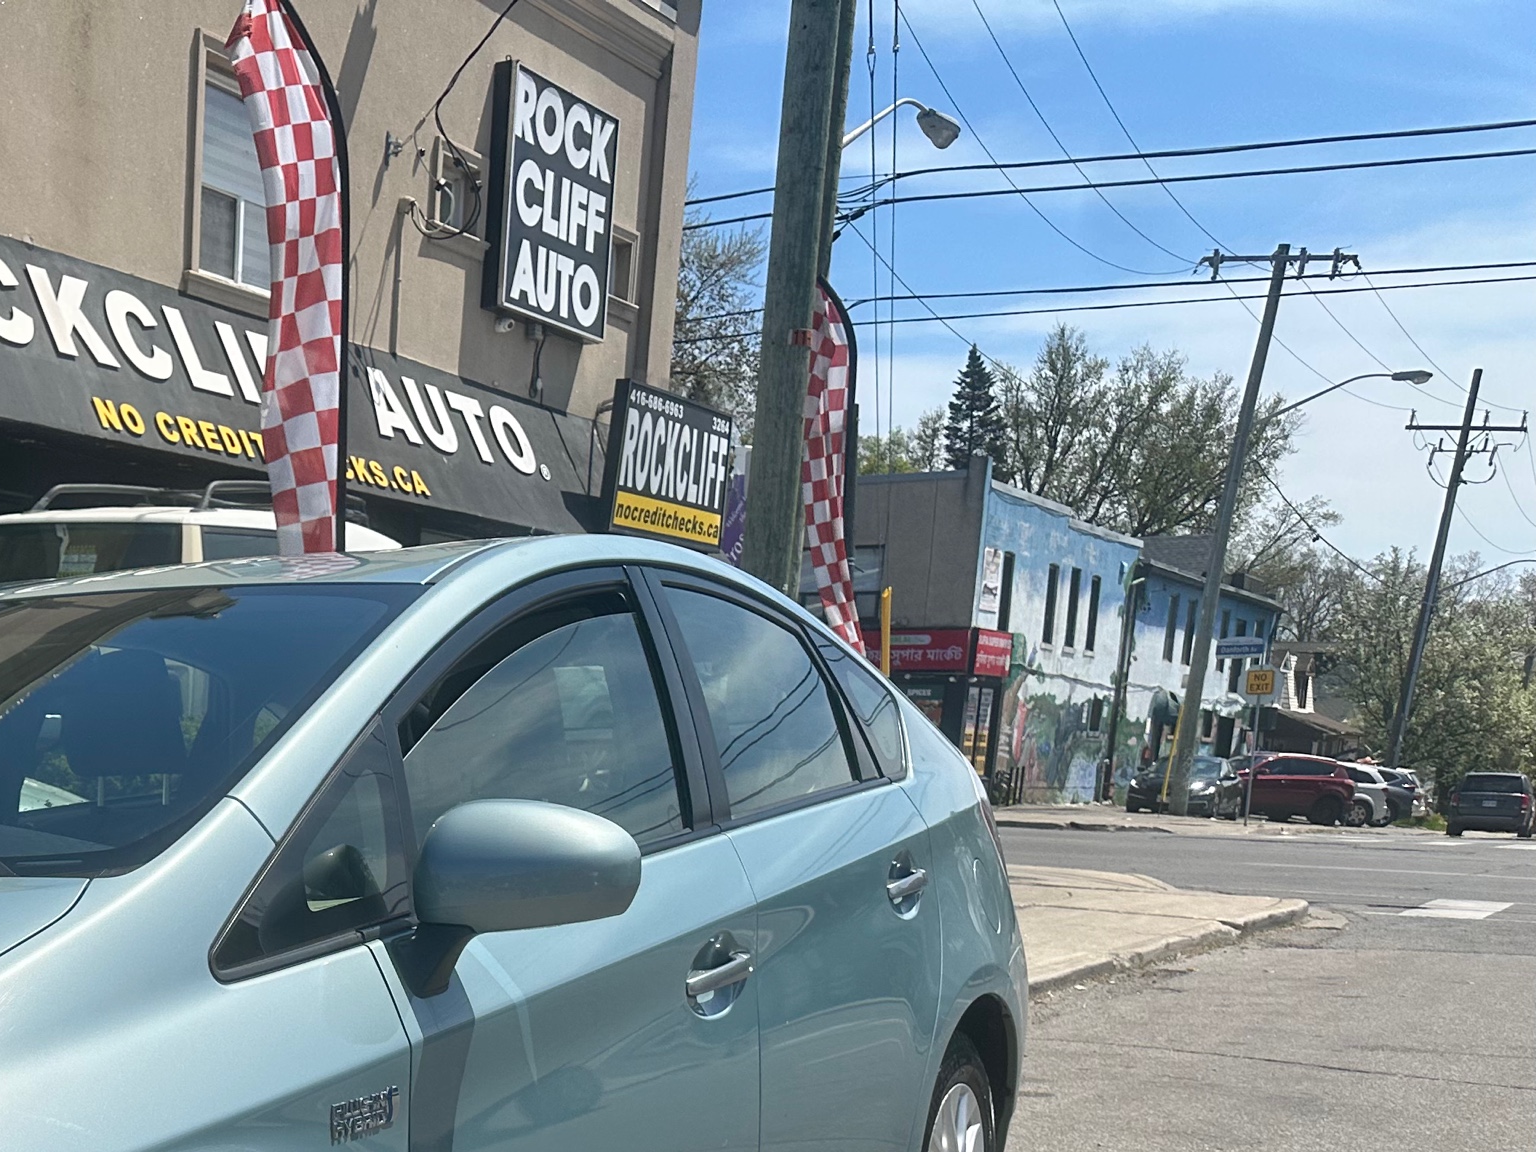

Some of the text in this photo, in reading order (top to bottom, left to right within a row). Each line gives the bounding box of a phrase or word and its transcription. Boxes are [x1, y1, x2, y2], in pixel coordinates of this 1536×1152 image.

[514, 69, 615, 184] ROCK
[516, 159, 606, 253] CLIFF
[510, 238, 600, 328] AUTO
[93, 396, 145, 436] NO
[712, 416, 730, 434] 3264
[619, 407, 728, 509] ROCKCLIFF
[615, 503, 720, 539] nocreditchecks.ca
[1249, 683, 1269, 692] EXIT
[1254, 673, 1267, 682] NO
